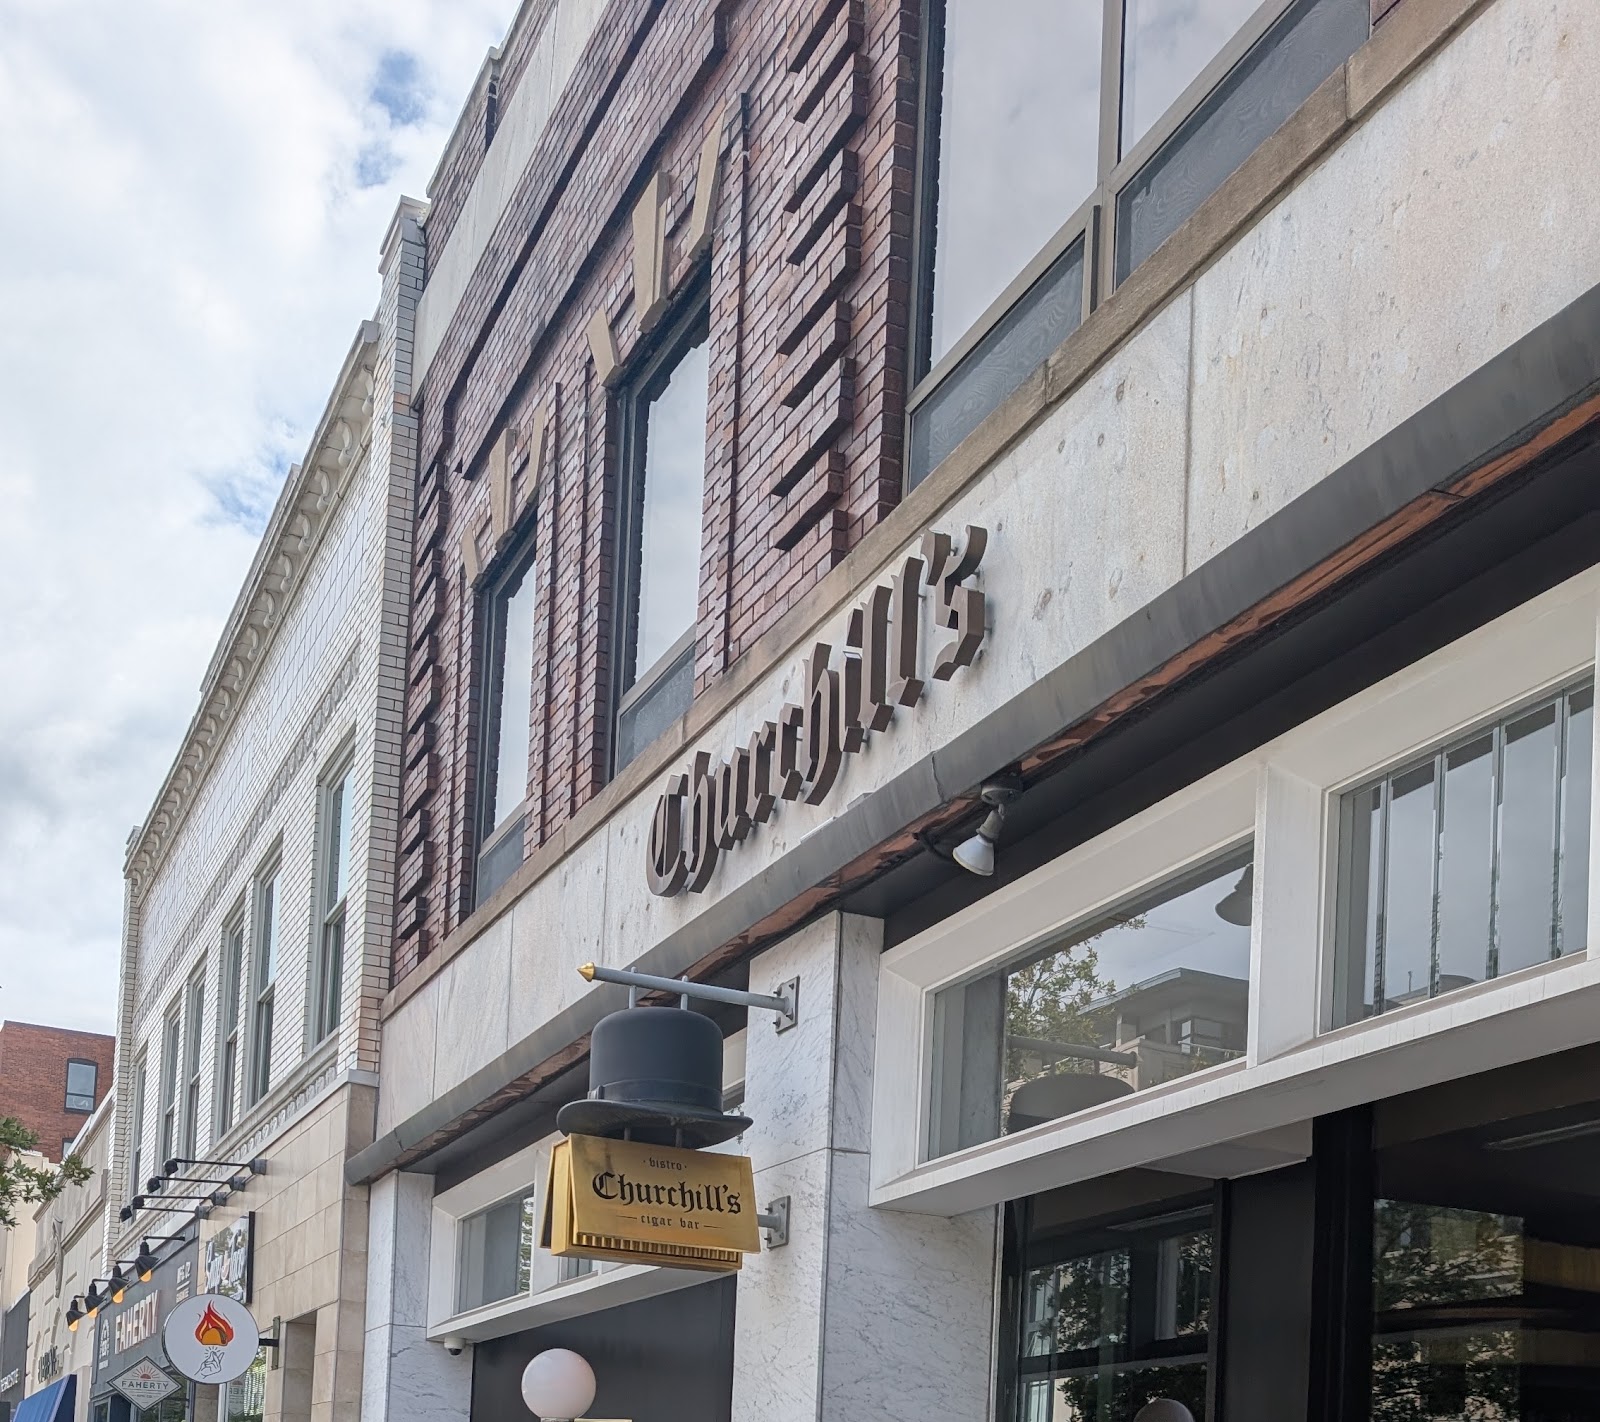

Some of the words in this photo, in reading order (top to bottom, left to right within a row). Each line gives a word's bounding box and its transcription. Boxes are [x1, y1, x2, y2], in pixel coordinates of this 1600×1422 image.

[646, 525, 987, 897] Churchill's
[649, 1157, 682, 1171] bistro
[592, 1171, 741, 1215] Churchill's
[640, 1215, 672, 1227] cigar
[680, 1217, 700, 1230] bar
[114, 1289, 159, 1355] FAHERTY
[121, 1381, 169, 1390] FAHERTY
